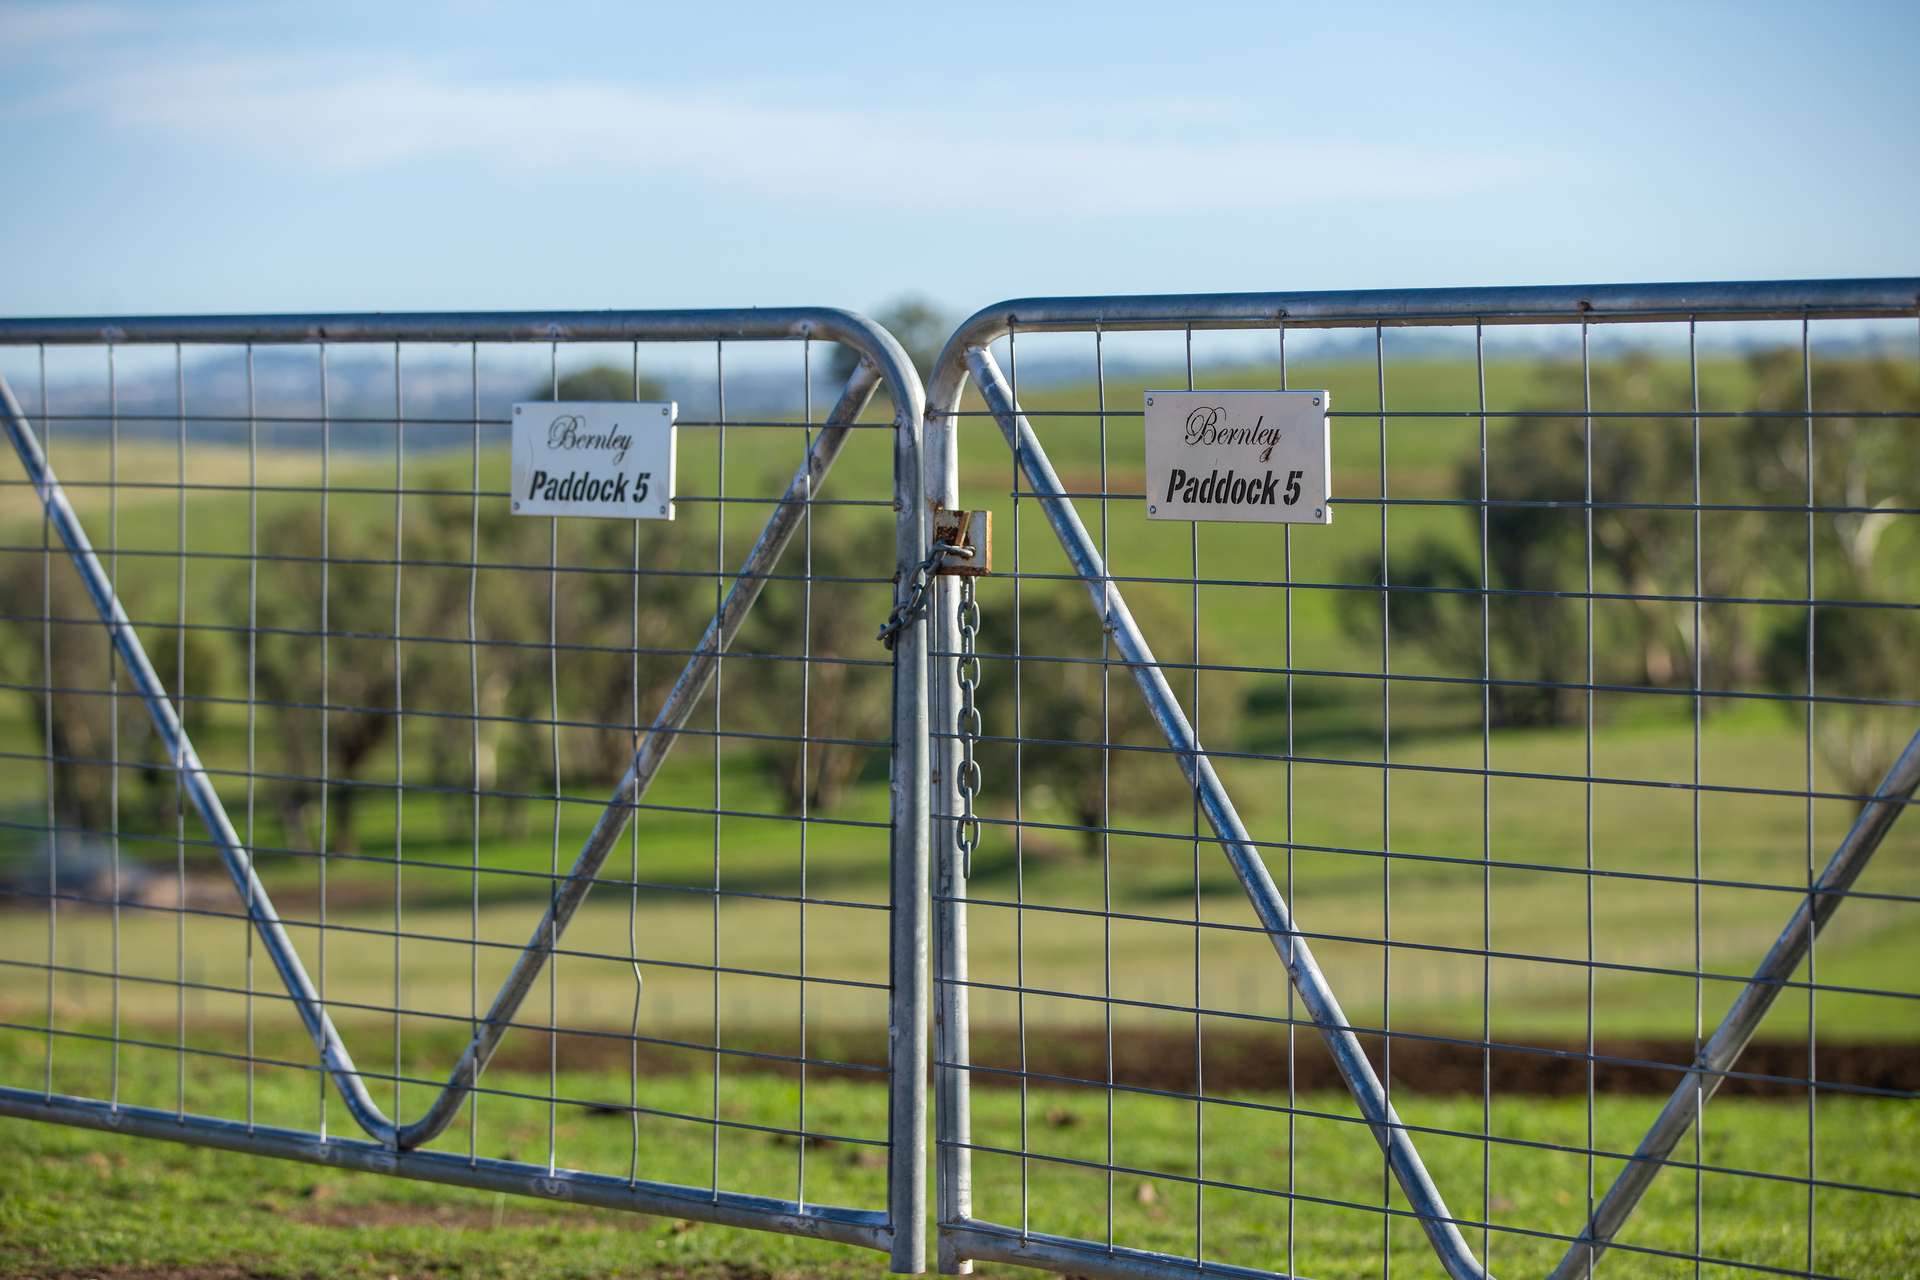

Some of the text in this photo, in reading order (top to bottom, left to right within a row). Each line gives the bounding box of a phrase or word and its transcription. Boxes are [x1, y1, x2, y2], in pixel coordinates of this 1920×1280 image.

[547, 414, 633, 465] Bernley
[1184, 406, 1281, 463] Bernley
[529, 470, 652, 504] Paddock 5
[1166, 468, 1304, 506] Paddock 5
